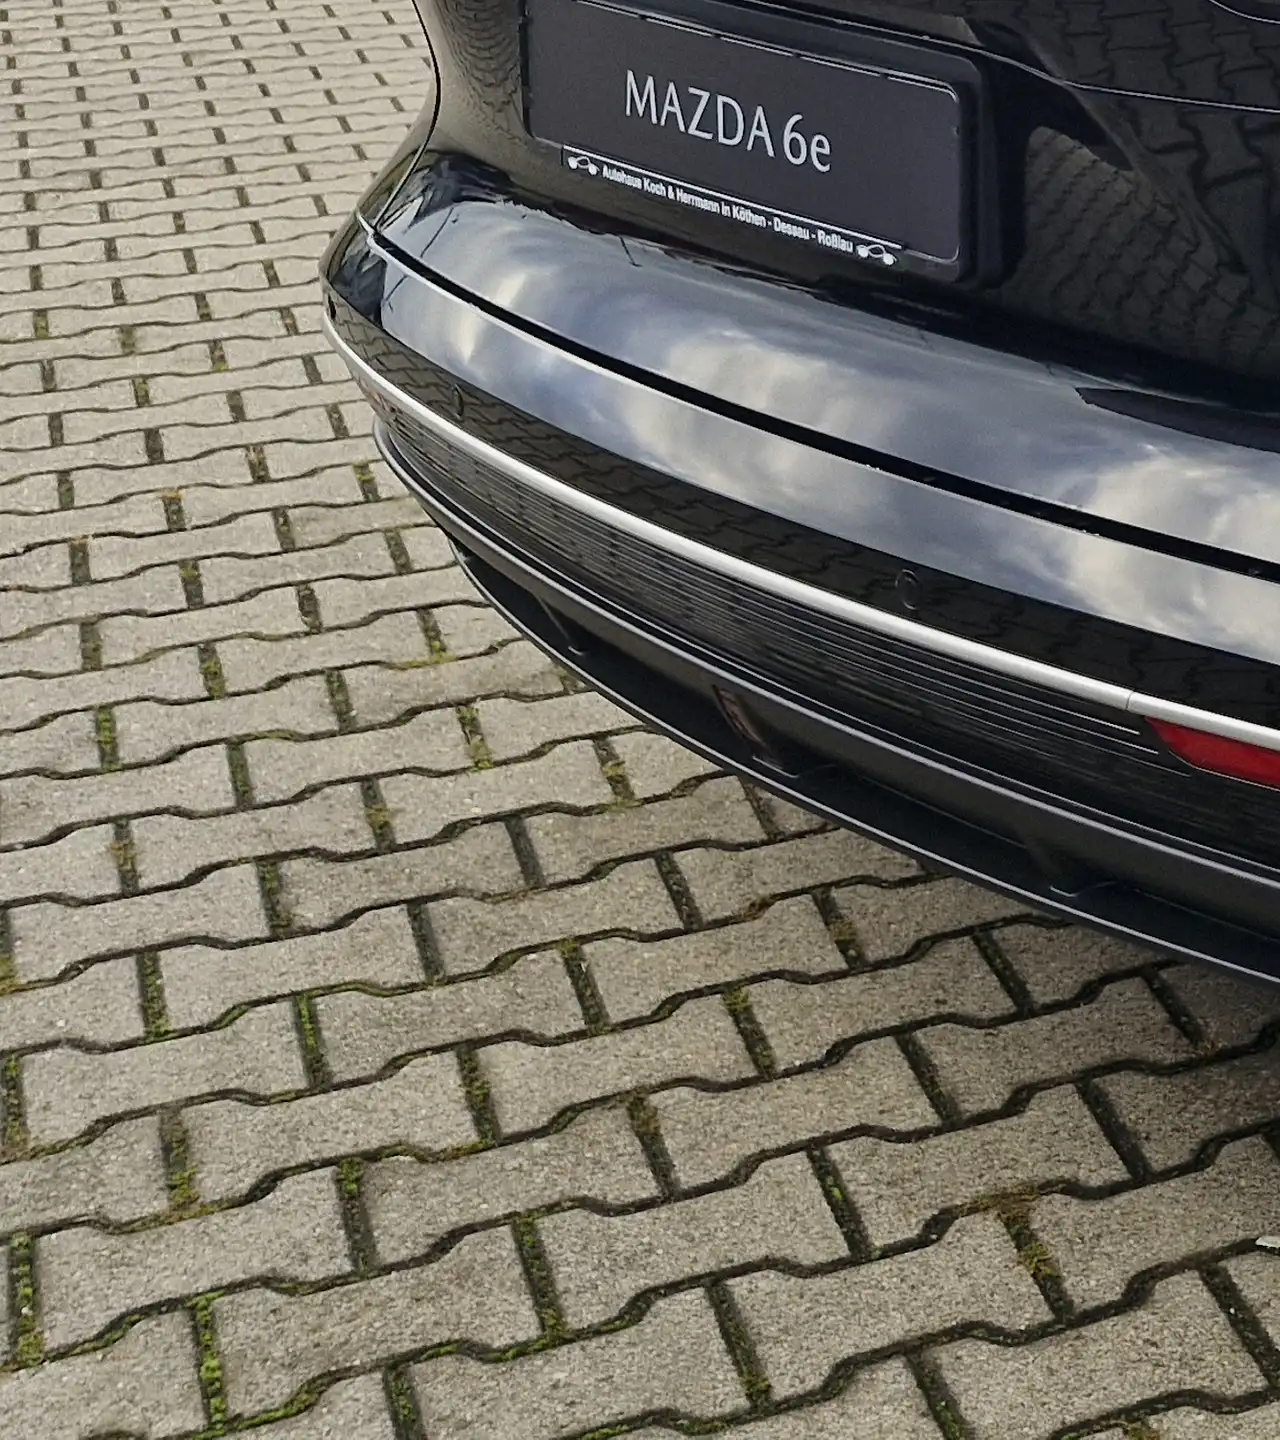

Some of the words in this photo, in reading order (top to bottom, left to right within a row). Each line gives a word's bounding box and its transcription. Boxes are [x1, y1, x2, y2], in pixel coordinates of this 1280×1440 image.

[602, 164, 643, 191] Autohaus
[643, 176, 667, 198] Koch
[667, 188, 675, 201] &
[676, 188, 720, 214] Herrmann
[732, 205, 766, 229] Köthen
[773, 217, 810, 241] Dessau
[817, 229, 853, 253] Roßlau
